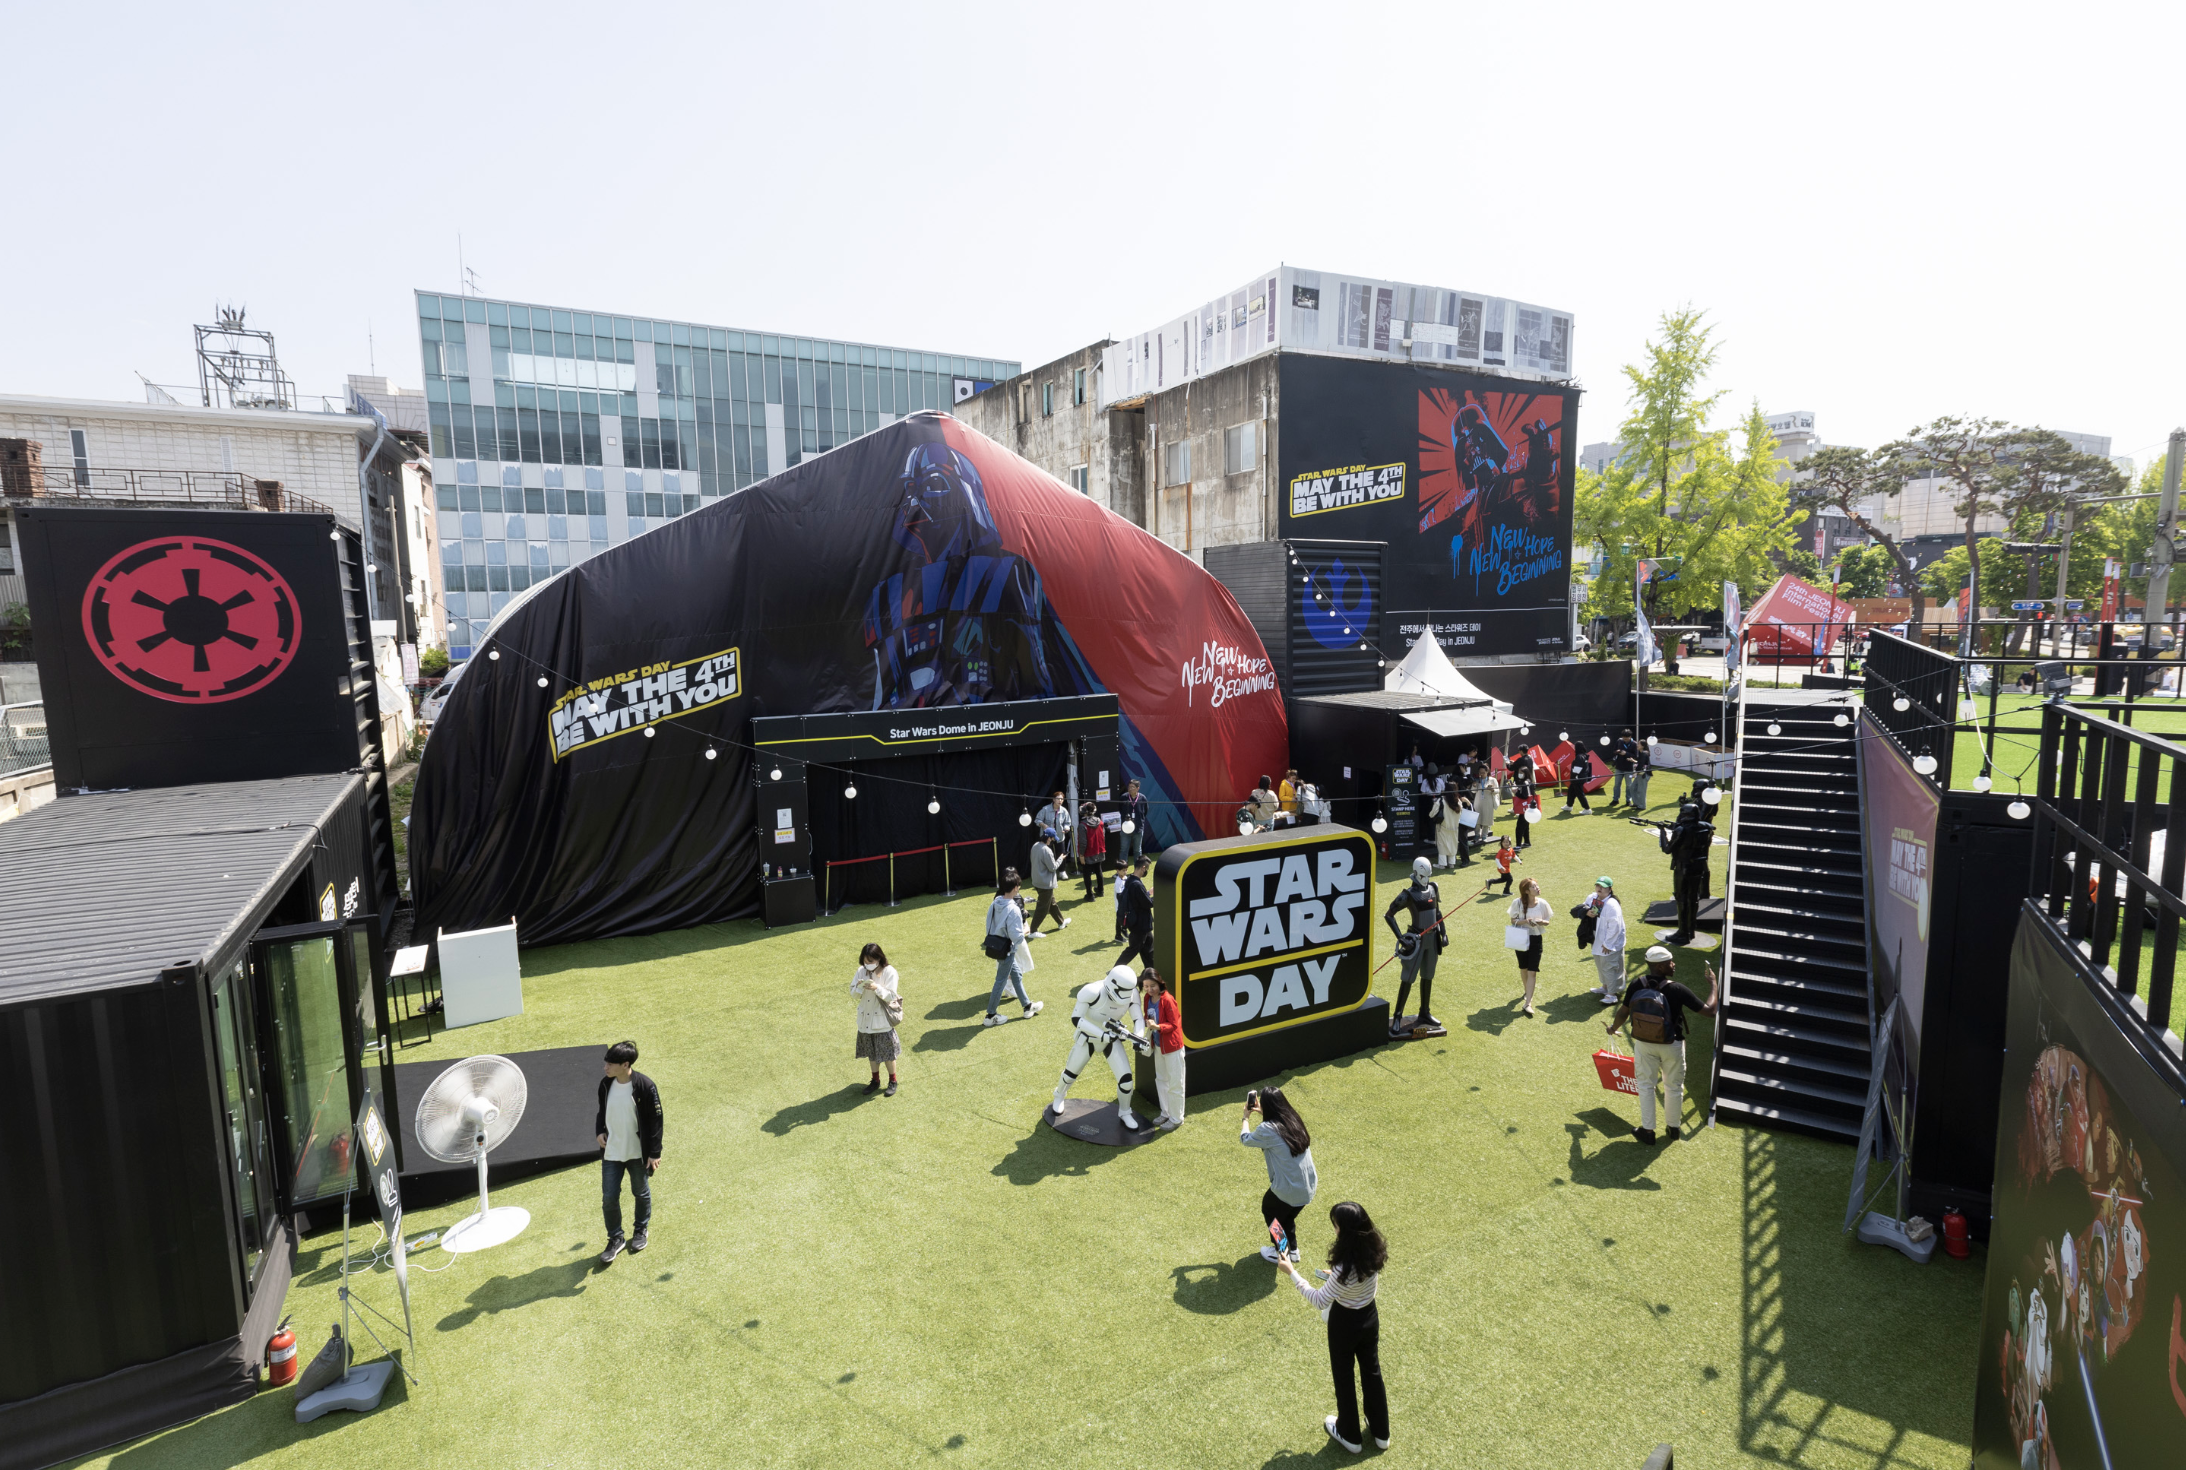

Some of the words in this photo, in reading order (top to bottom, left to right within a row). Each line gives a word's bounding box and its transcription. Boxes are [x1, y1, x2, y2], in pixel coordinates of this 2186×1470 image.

[1293, 477, 1334, 499] MAY
[1339, 471, 1374, 491] THE
[1378, 465, 1403, 484] 4TH
[1298, 472, 1322, 481] STAR
[1322, 466, 1348, 478] WARS
[1350, 464, 1366, 473] DAY
[1293, 495, 1317, 515] BE
[1320, 487, 1364, 509] WITH
[1367, 481, 1402, 501] YOU
[1490, 523, 1528, 554] NEW
[1525, 535, 1554, 557] HOPE
[1470, 543, 1501, 581] NEW
[1497, 550, 1562, 596] BEGINNING
[1781, 593, 1802, 607] Film
[1787, 582, 1808, 597] 24th
[1202, 640, 1239, 669] NEW
[1237, 654, 1267, 674] HOPE
[1406, 638, 1418, 647] Sta
[1447, 637, 1453, 646] in
[1454, 636, 1476, 645] JEONJU
[551, 688, 612, 736] MAY
[621, 667, 687, 705] THE
[694, 652, 736, 684] 4TH
[555, 685, 588, 709] STAR
[588, 669, 638, 692] WARS
[641, 660, 671, 678] DAY
[1182, 657, 1213, 693] NEW
[1211, 672, 1275, 708] BEGINNING
[556, 720, 585, 759] BE
[587, 694, 672, 738] WITH
[676, 673, 737, 711] YOU
[890, 729, 910, 739] Star
[912, 727, 937, 737] Wars
[939, 725, 966, 735] Dome
[967, 723, 977, 732] in
[978, 719, 1014, 732] JEONJU
[1190, 848, 1366, 919] STAR
[1190, 891, 1365, 967] WARS
[1219, 954, 1342, 1028] DAY
[1621, 1075, 1638, 1086] THE
